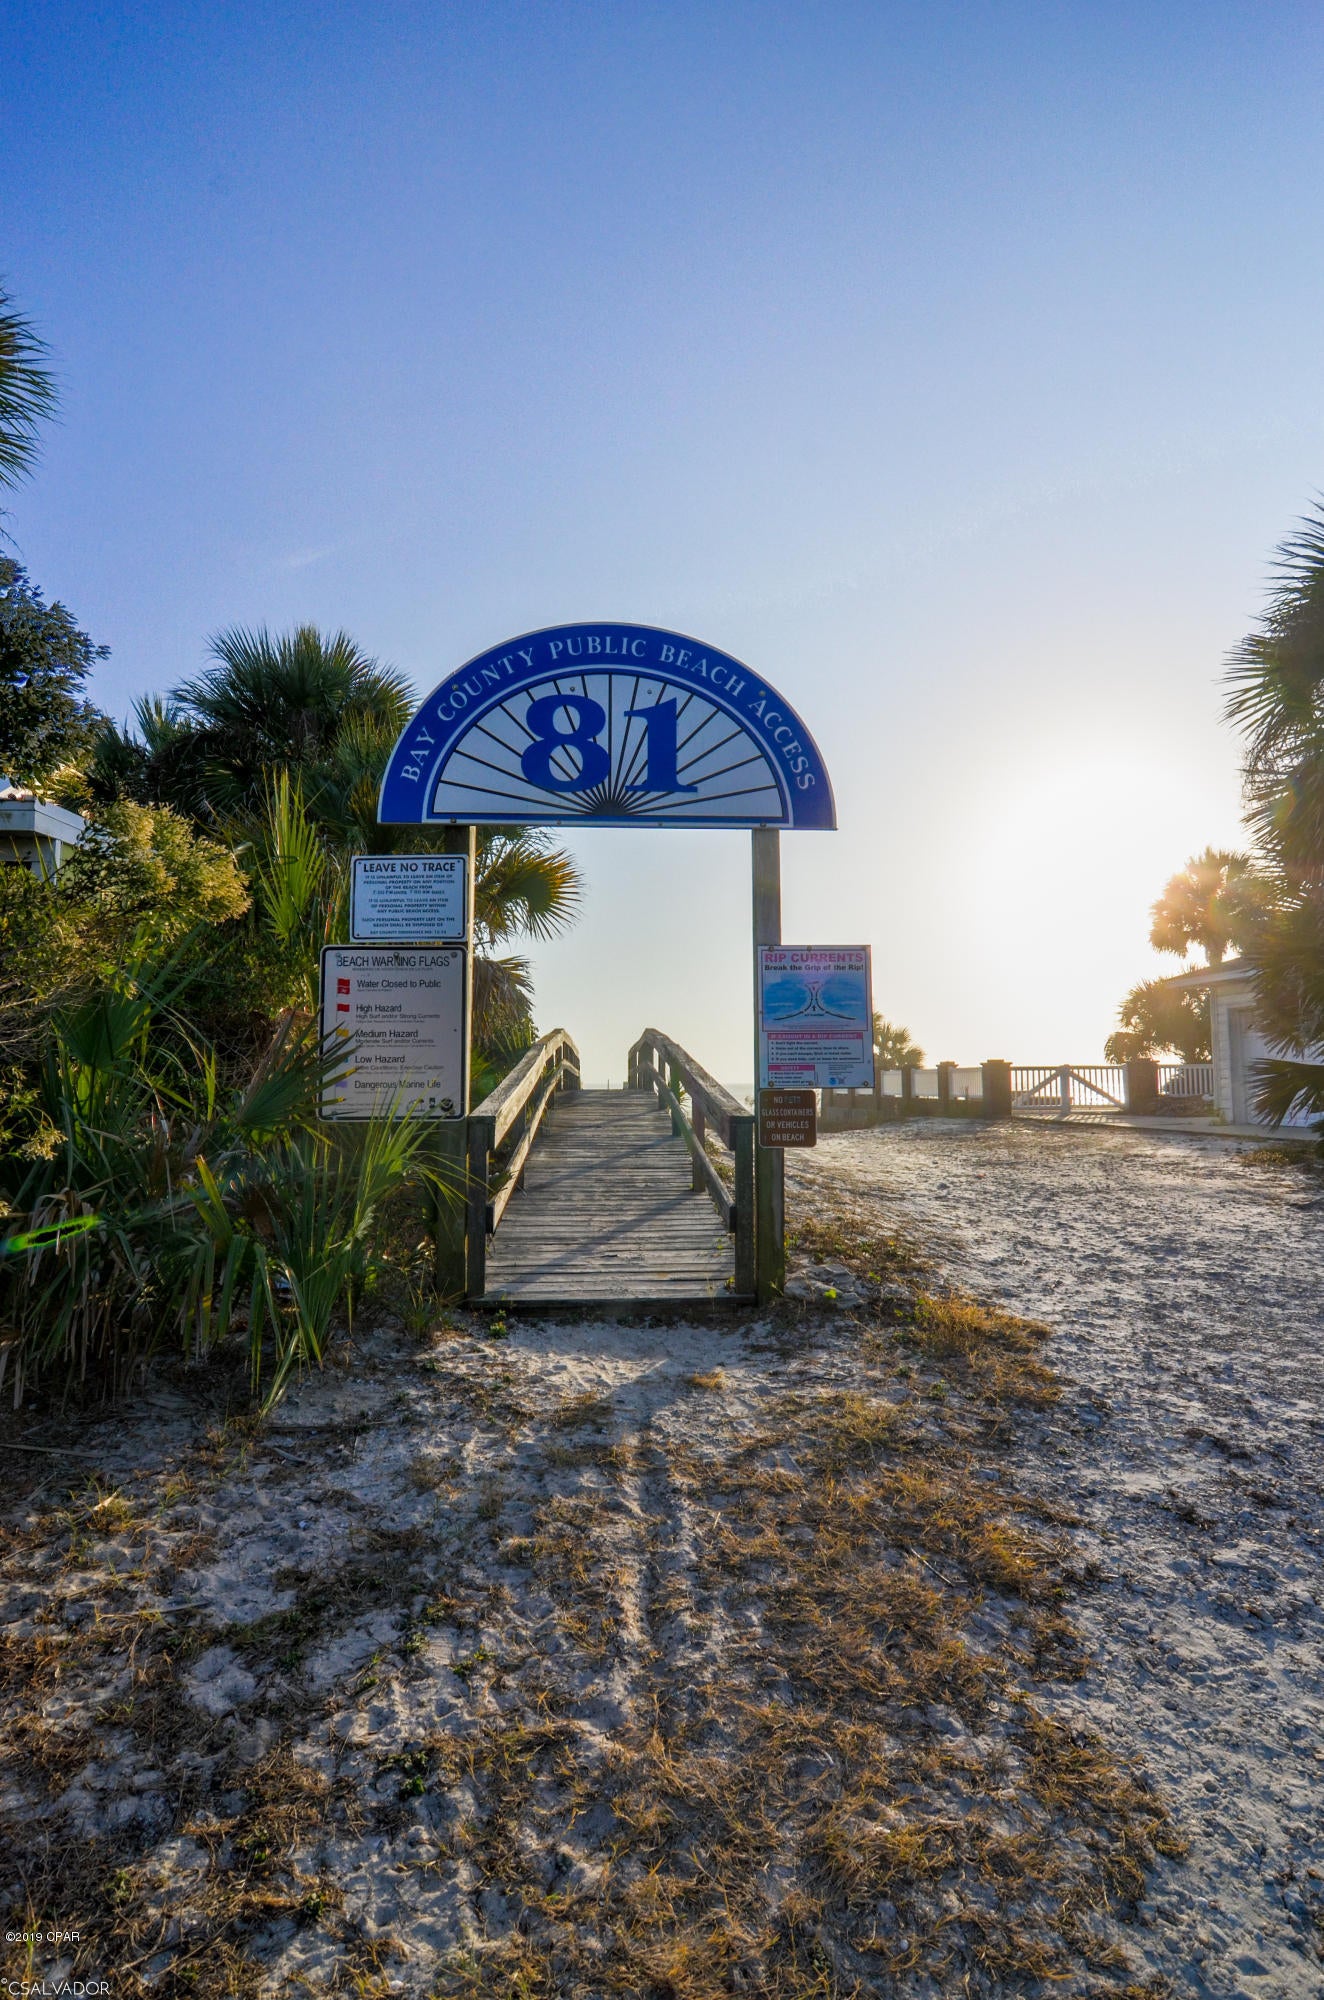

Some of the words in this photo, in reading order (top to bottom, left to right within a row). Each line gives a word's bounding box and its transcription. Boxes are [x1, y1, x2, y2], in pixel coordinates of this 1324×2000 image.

[400, 726, 434, 782] BAY
[437, 648, 533, 720] COUNTY
[550, 636, 646, 659] PUBLIC
[658, 644, 746, 697] BEACH
[748, 700, 815, 790] ACCESS
[520, 695, 698, 792] 81
[364, 862, 396, 872] LEAVE
[400, 862, 418, 872] NO
[422, 862, 456, 872] TRACE
[336, 956, 368, 966] BEACH
[372, 956, 416, 966] WARNING
[419, 956, 450, 966] FLAGS
[764, 953, 786, 962] RIP
[791, 953, 863, 962] CURRENTS
[357, 980, 379, 988] Water
[382, 980, 407, 988] Closed
[410, 980, 418, 988] to
[420, 980, 441, 988] Public
[356, 1004, 372, 1014] High
[375, 1004, 402, 1012] Hazard
[354, 1081, 397, 1090] Dangerous
[762, 1108, 779, 1116] GLASS
[780, 1108, 814, 1116] CONTAINERS
[766, 1120, 776, 1128] OR
[777, 1120, 809, 1128] VEHICLES
[772, 1133, 781, 1142] ON
[782, 1133, 805, 1142] BEACH
